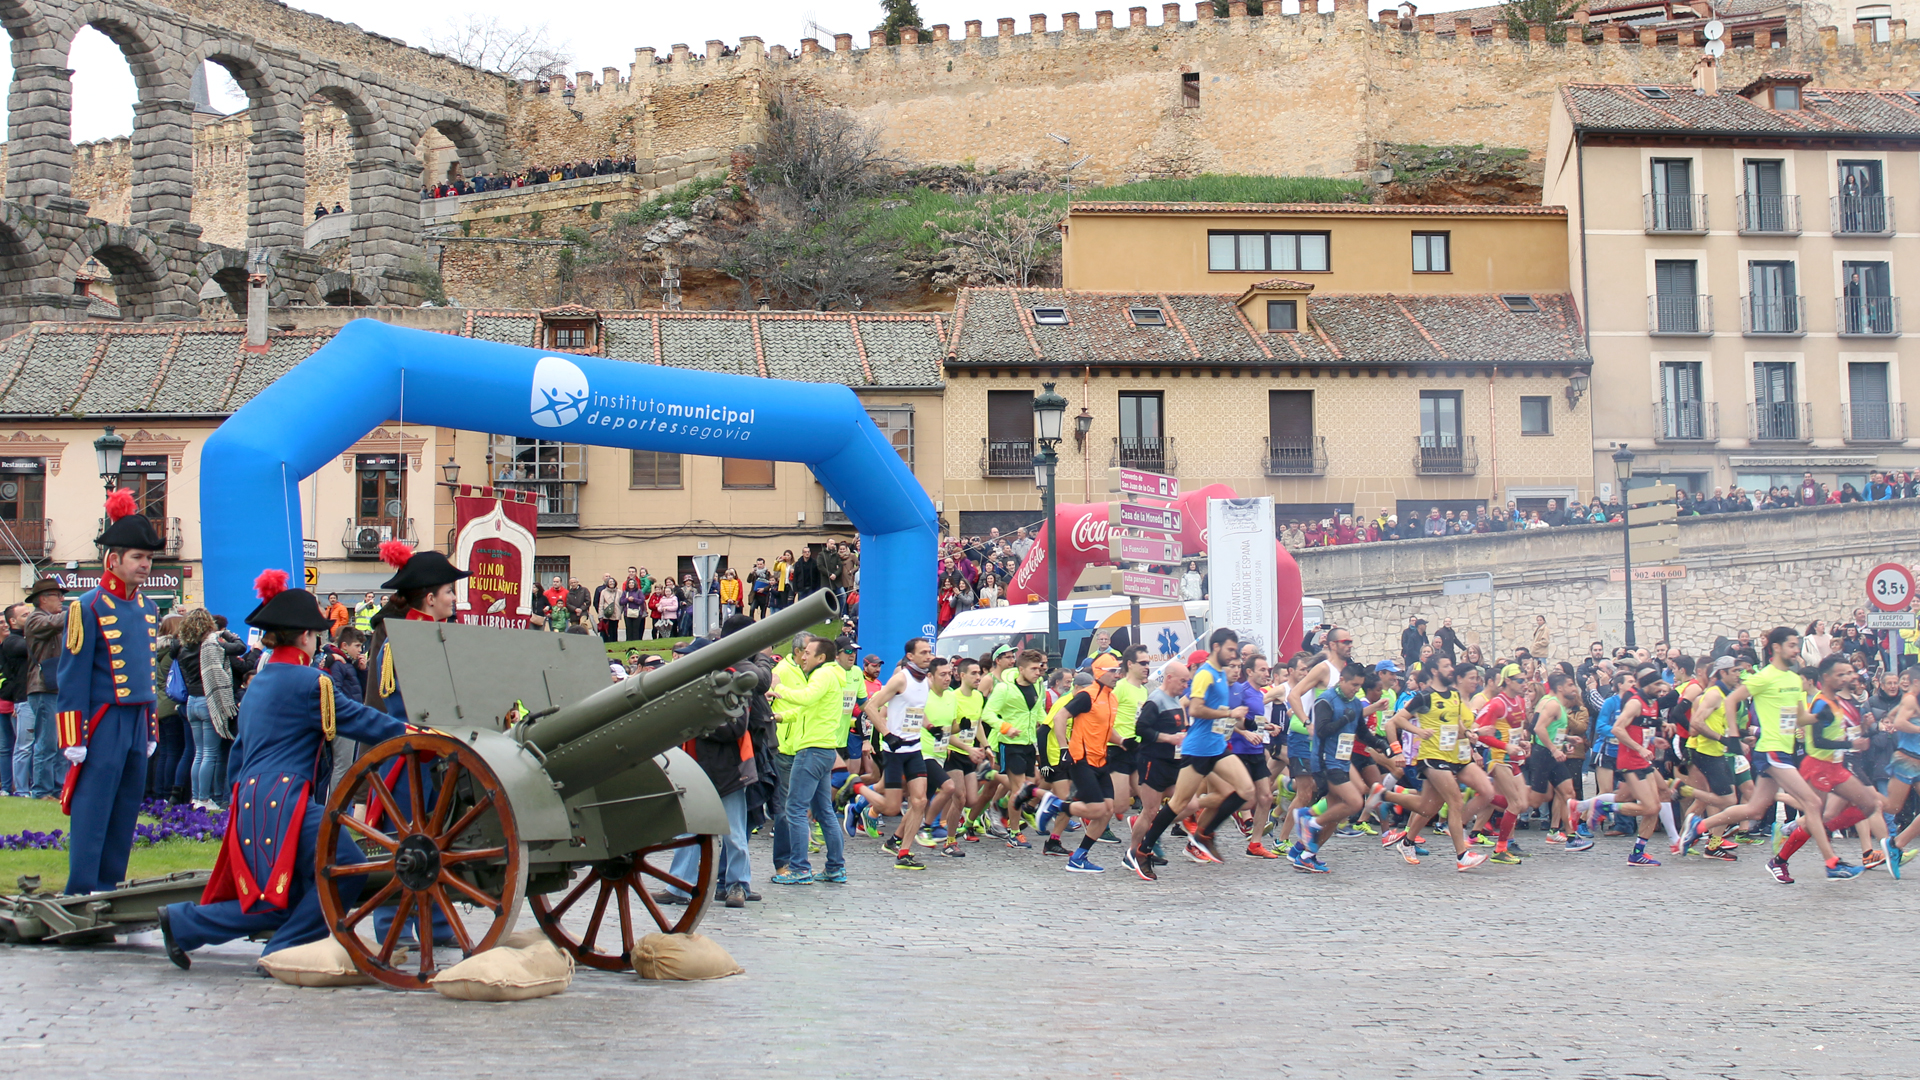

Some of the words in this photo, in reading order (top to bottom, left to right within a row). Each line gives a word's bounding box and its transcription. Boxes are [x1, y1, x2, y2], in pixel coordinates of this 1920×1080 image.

[1122, 472, 1138, 481] Convento
[1130, 482, 1138, 490] Juan
[1147, 485, 1156, 493] Cruz
[1122, 510, 1133, 520] Casa
[1134, 512, 1140, 521] de
[1140, 512, 1145, 522] la
[1146, 513, 1163, 524] Moneda
[1129, 545, 1148, 554] Fuencisla
[1241, 540, 1251, 568] ESPAÑA
[138, 574, 178, 588] undo
[1242, 570, 1251, 579] DE
[470, 576, 476, 589] DE
[1232, 582, 1241, 625] CERVANTES
[1242, 581, 1252, 624] EMBAJADOR
